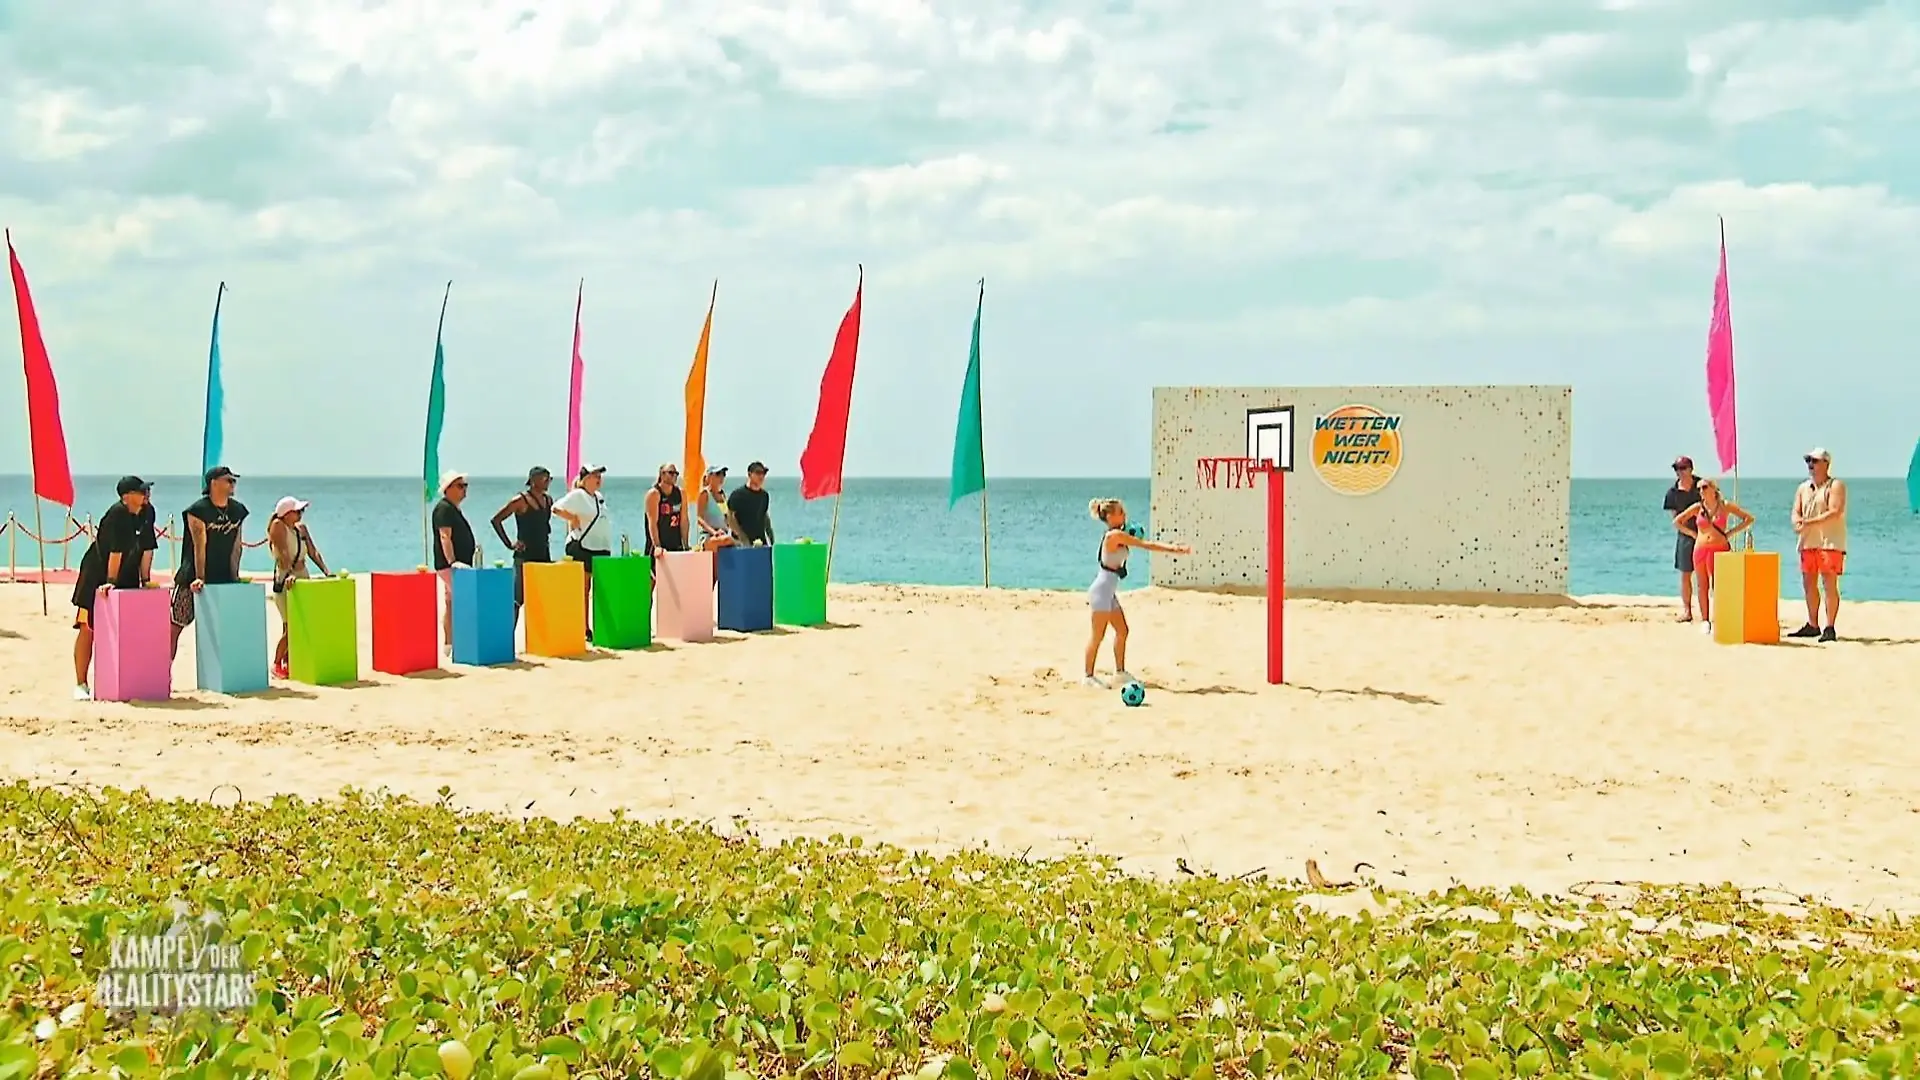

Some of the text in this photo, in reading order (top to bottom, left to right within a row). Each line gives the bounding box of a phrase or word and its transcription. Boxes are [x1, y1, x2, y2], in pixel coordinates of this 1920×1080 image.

[1315, 416, 1400, 430] WETTEN
[1334, 434, 1380, 447] WER
[1322, 450, 1390, 464] NICHT!
